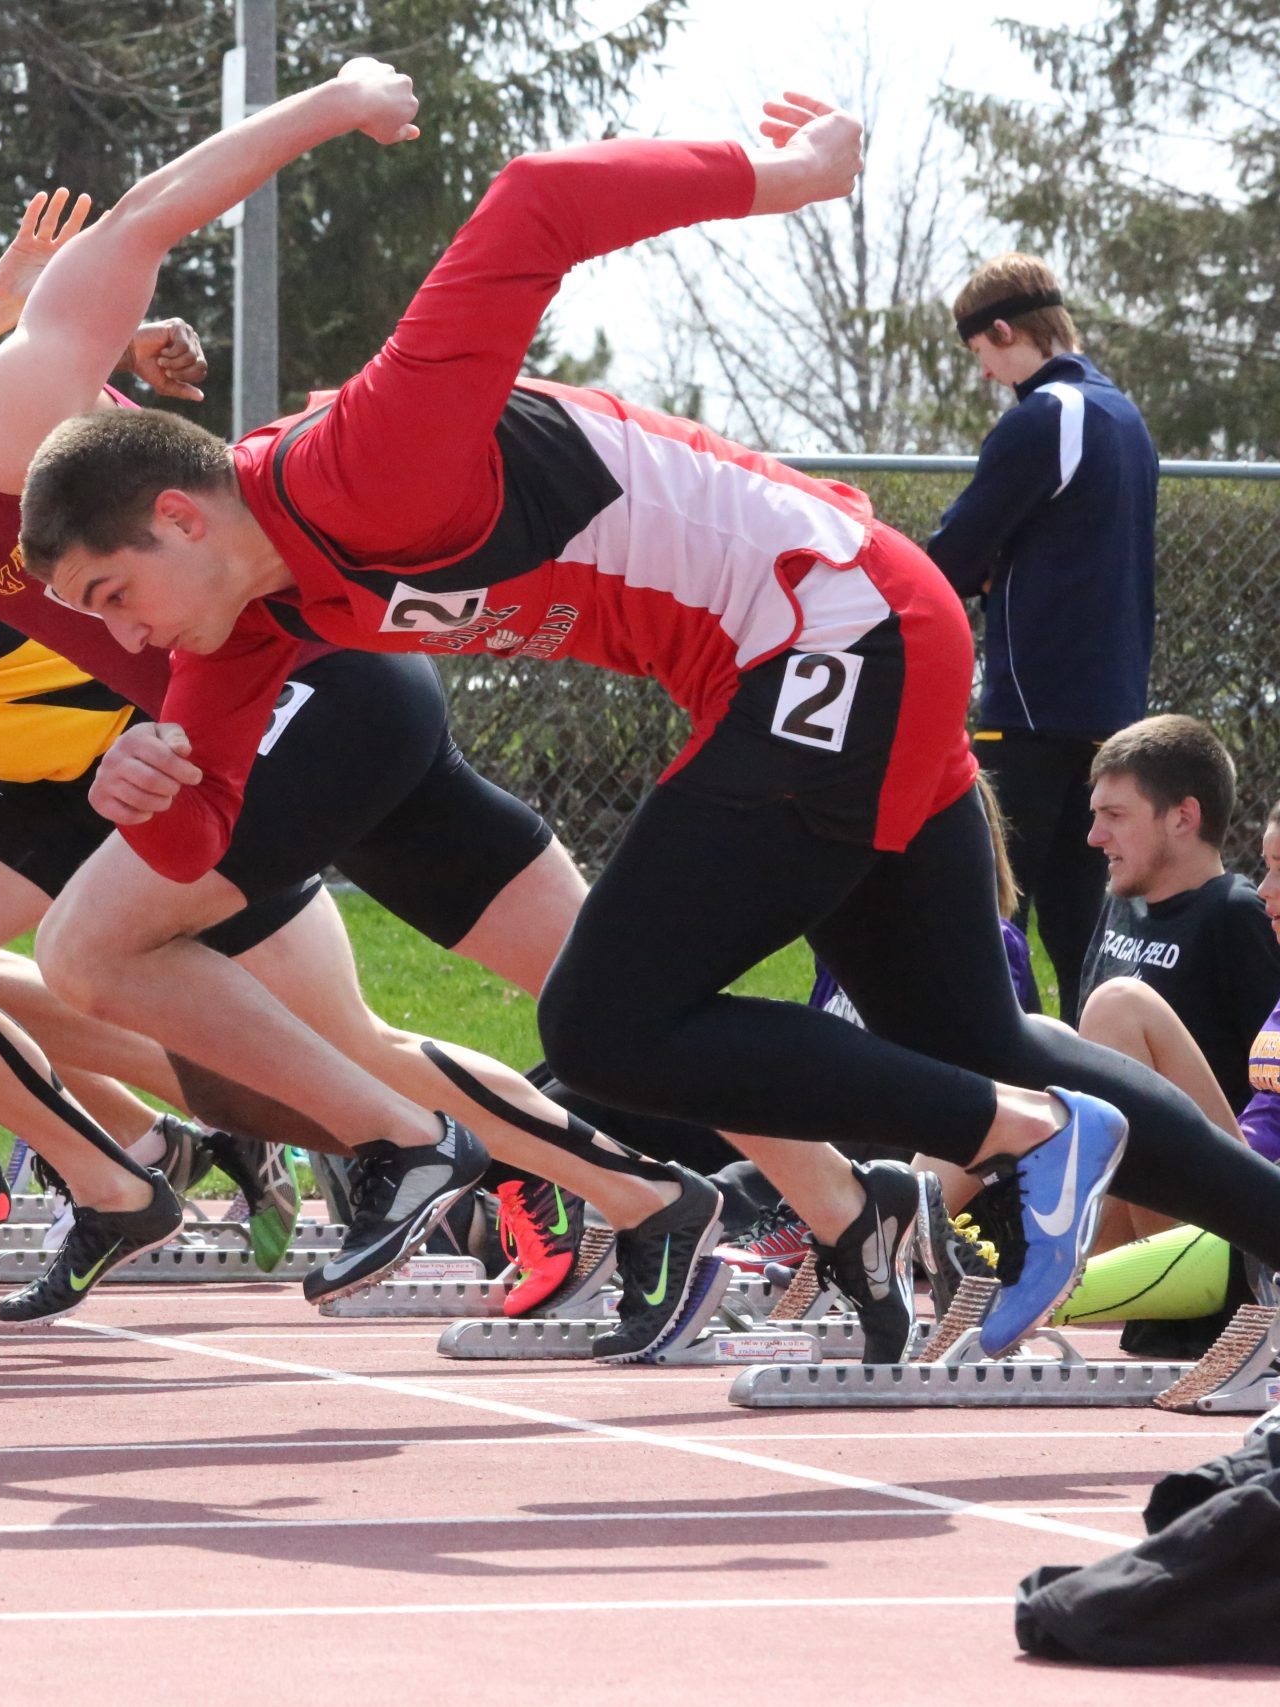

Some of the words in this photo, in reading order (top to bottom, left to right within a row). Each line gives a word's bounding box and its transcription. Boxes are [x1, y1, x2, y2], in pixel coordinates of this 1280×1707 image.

[391, 598, 480, 629] 2
[781, 653, 847, 743] 2
[1098, 929, 1138, 962] RACK
[1139, 942, 1181, 970] FIELD
[436, 1114, 456, 1160] NIKE
